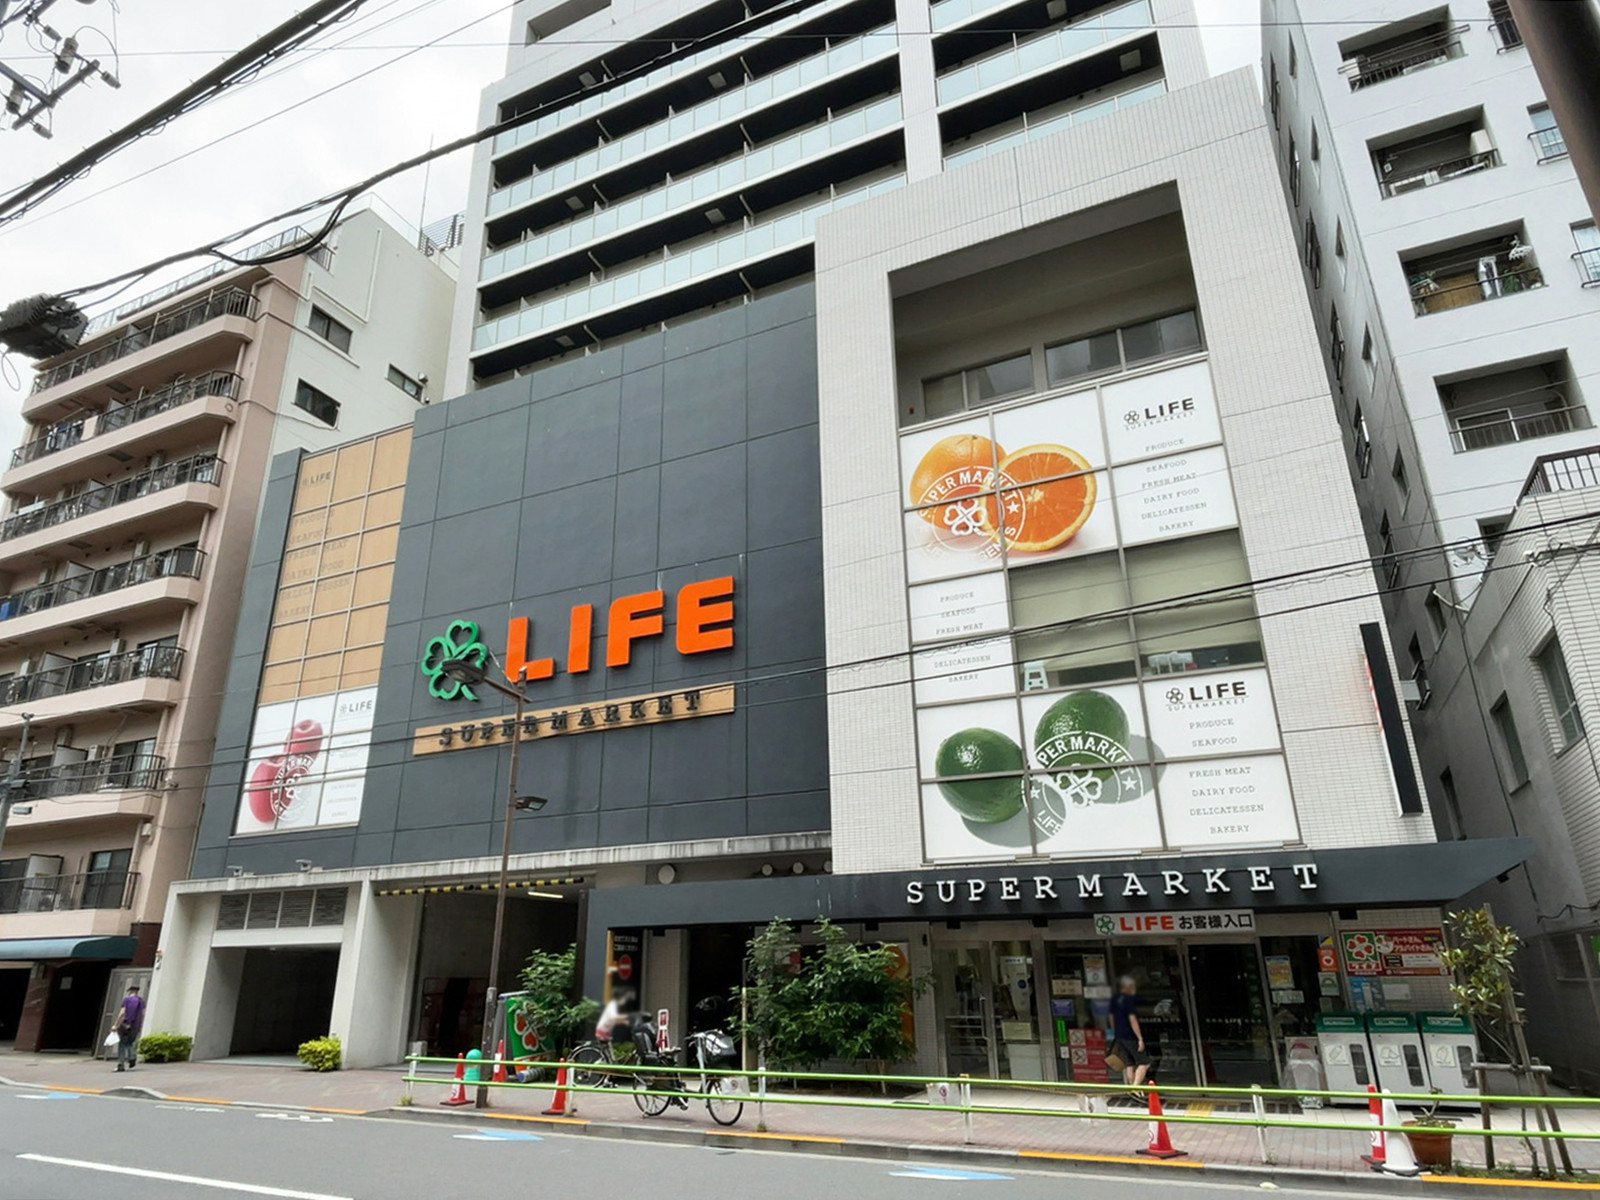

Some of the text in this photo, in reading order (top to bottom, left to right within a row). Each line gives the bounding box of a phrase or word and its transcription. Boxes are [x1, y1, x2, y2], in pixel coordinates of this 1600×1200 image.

[1144, 397, 1195, 420] LIFE
[1145, 438, 1185, 452] PRODUCE
[1146, 459, 1187, 473] SEAFOOD
[310, 471, 331, 484] LIFE
[1141, 472, 1197, 489] FRESH MEAT
[1143, 487, 1200, 504] DAIRY FOOD
[1141, 501, 1208, 520] DELICATESSEN
[1158, 520, 1195, 533] BAKERY
[940, 591, 974, 603] PRODUCE
[505, 575, 733, 683] LIFE
[936, 622, 984, 635] FRESH MEAT
[934, 655, 991, 669] DELICATESSEN
[949, 674, 979, 683] BAKERY
[1189, 681, 1247, 701] LIFE
[348, 700, 373, 713] LIFE
[1168, 698, 1246, 711] SUPERMARKET
[1189, 718, 1234, 730] PRODUCE
[1192, 736, 1238, 748] SEAFOOD
[1189, 766, 1252, 779] FRESH MEAT
[1192, 785, 1256, 798] DAIRY FOOD
[1189, 803, 1265, 817] DELICATESSEN
[1209, 824, 1250, 835] BAKERY
[907, 863, 1318, 904] SUPERMARKET
[1119, 913, 1253, 932] LIFE お客様入口
